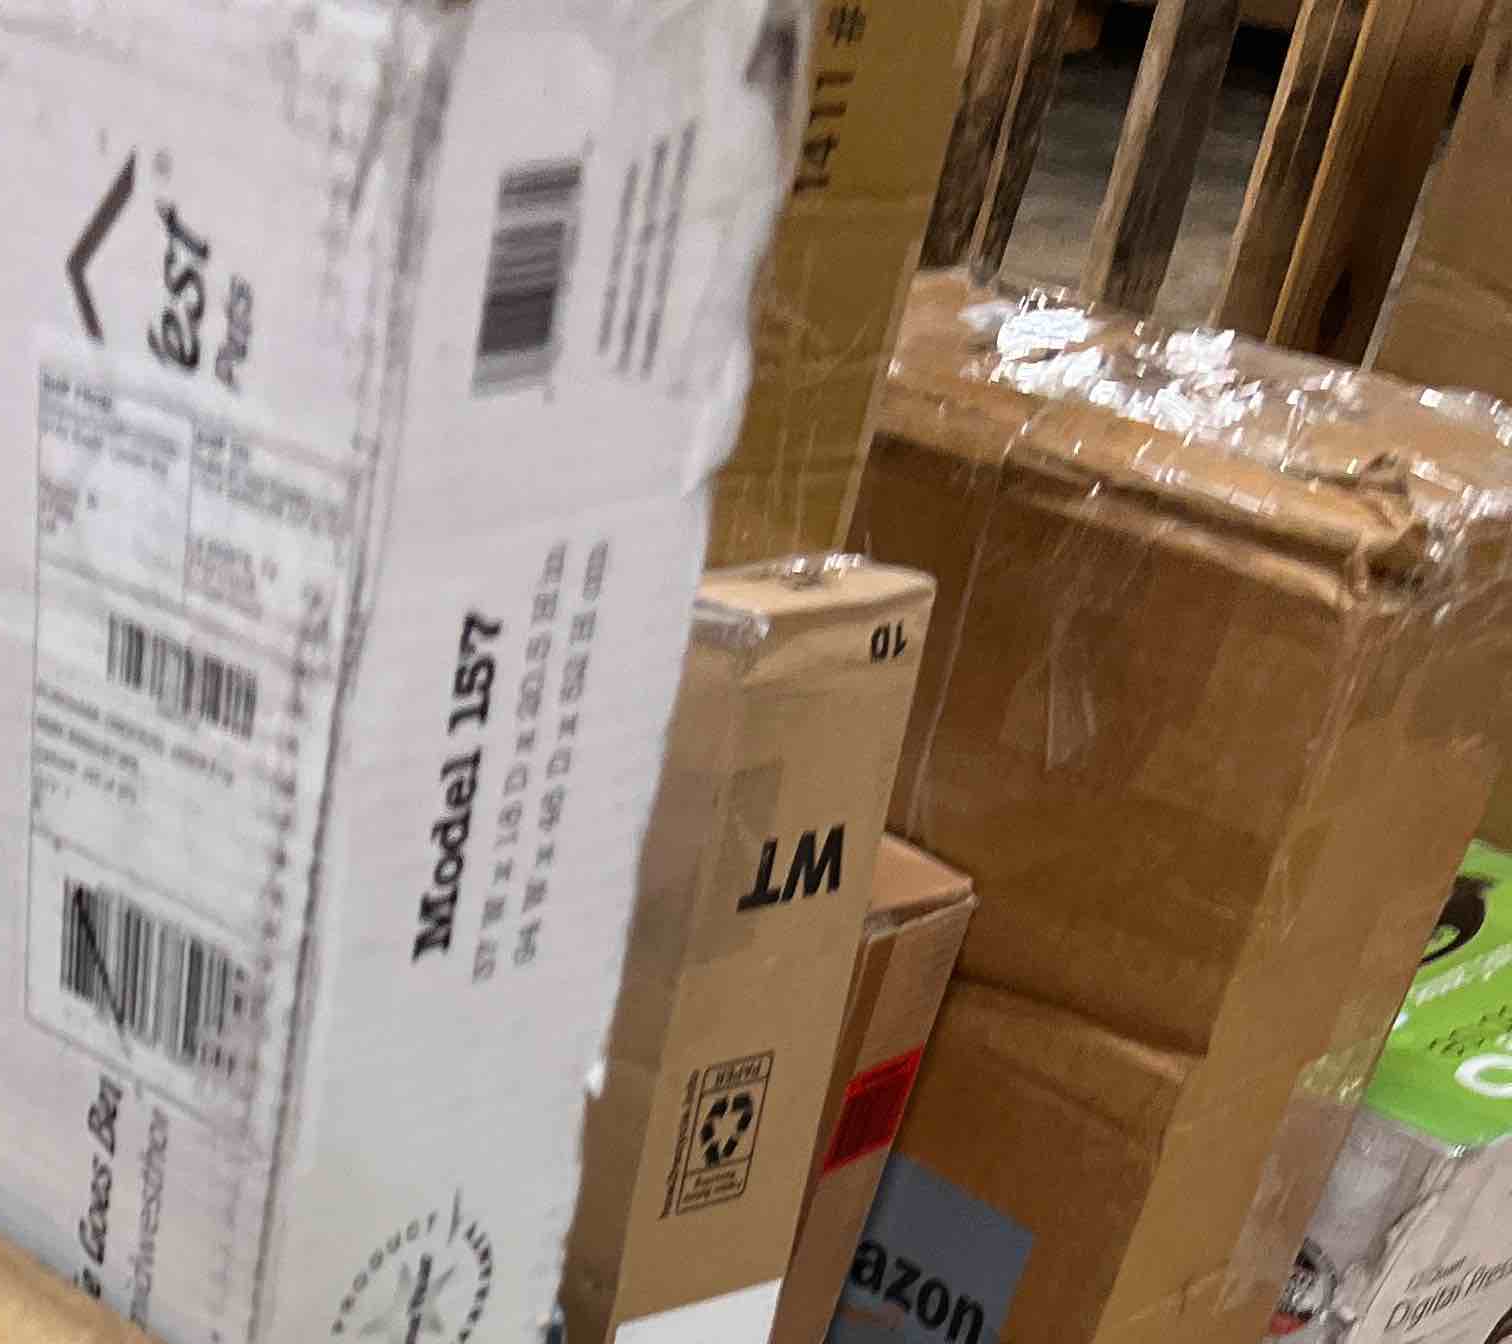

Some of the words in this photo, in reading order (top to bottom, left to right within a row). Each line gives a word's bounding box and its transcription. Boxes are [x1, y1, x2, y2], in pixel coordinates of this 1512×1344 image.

[411, 746, 482, 964] Model
[447, 608, 503, 736] 157
[736, 823, 846, 913] WT
